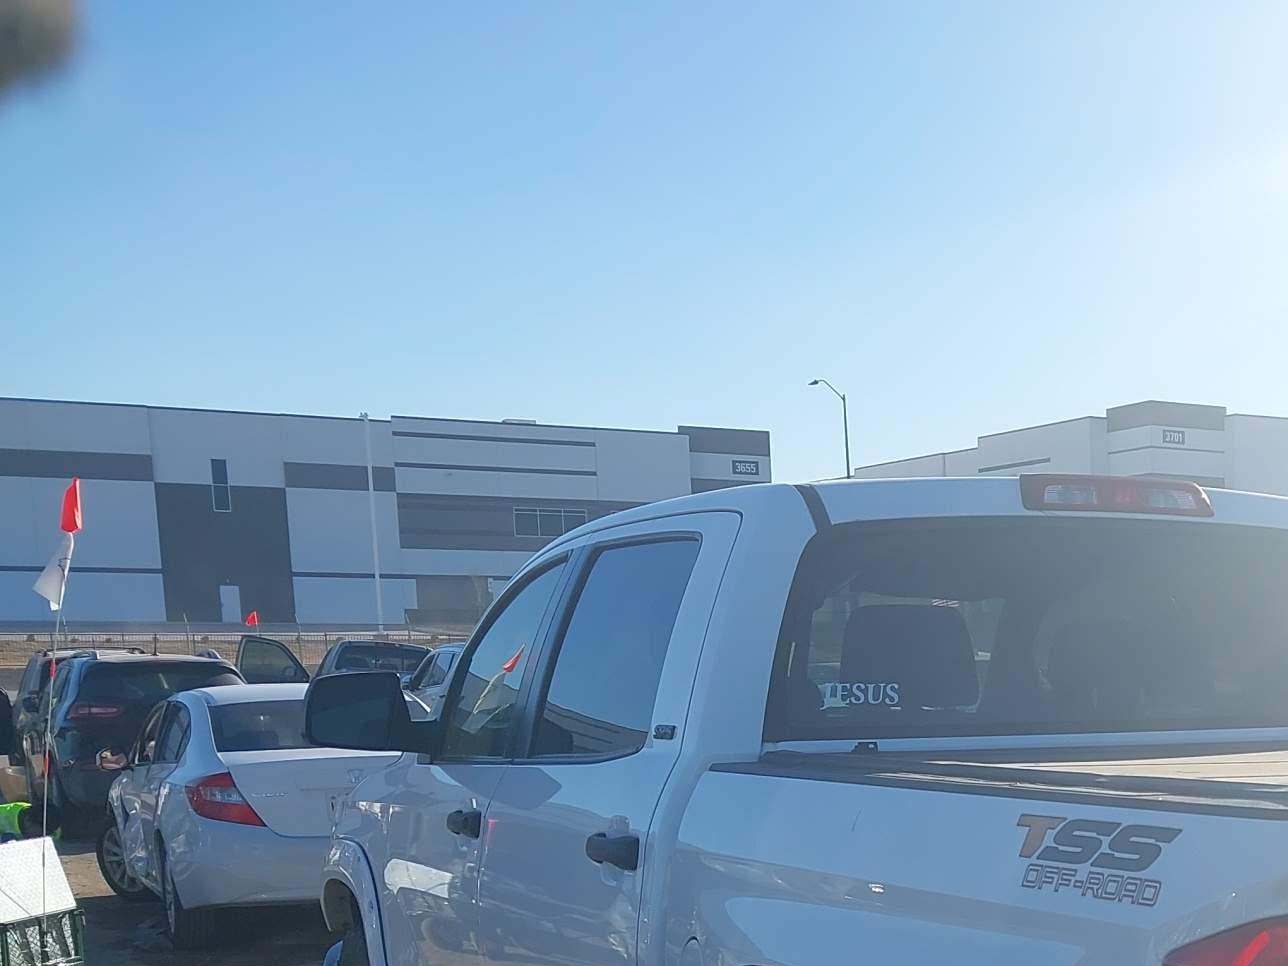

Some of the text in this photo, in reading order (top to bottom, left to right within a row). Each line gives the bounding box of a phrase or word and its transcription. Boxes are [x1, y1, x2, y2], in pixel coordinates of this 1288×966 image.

[735, 462, 756, 473] 3655
[1016, 813, 1183, 873] TSS
[1021, 863, 1162, 907] OFF-ROAD
